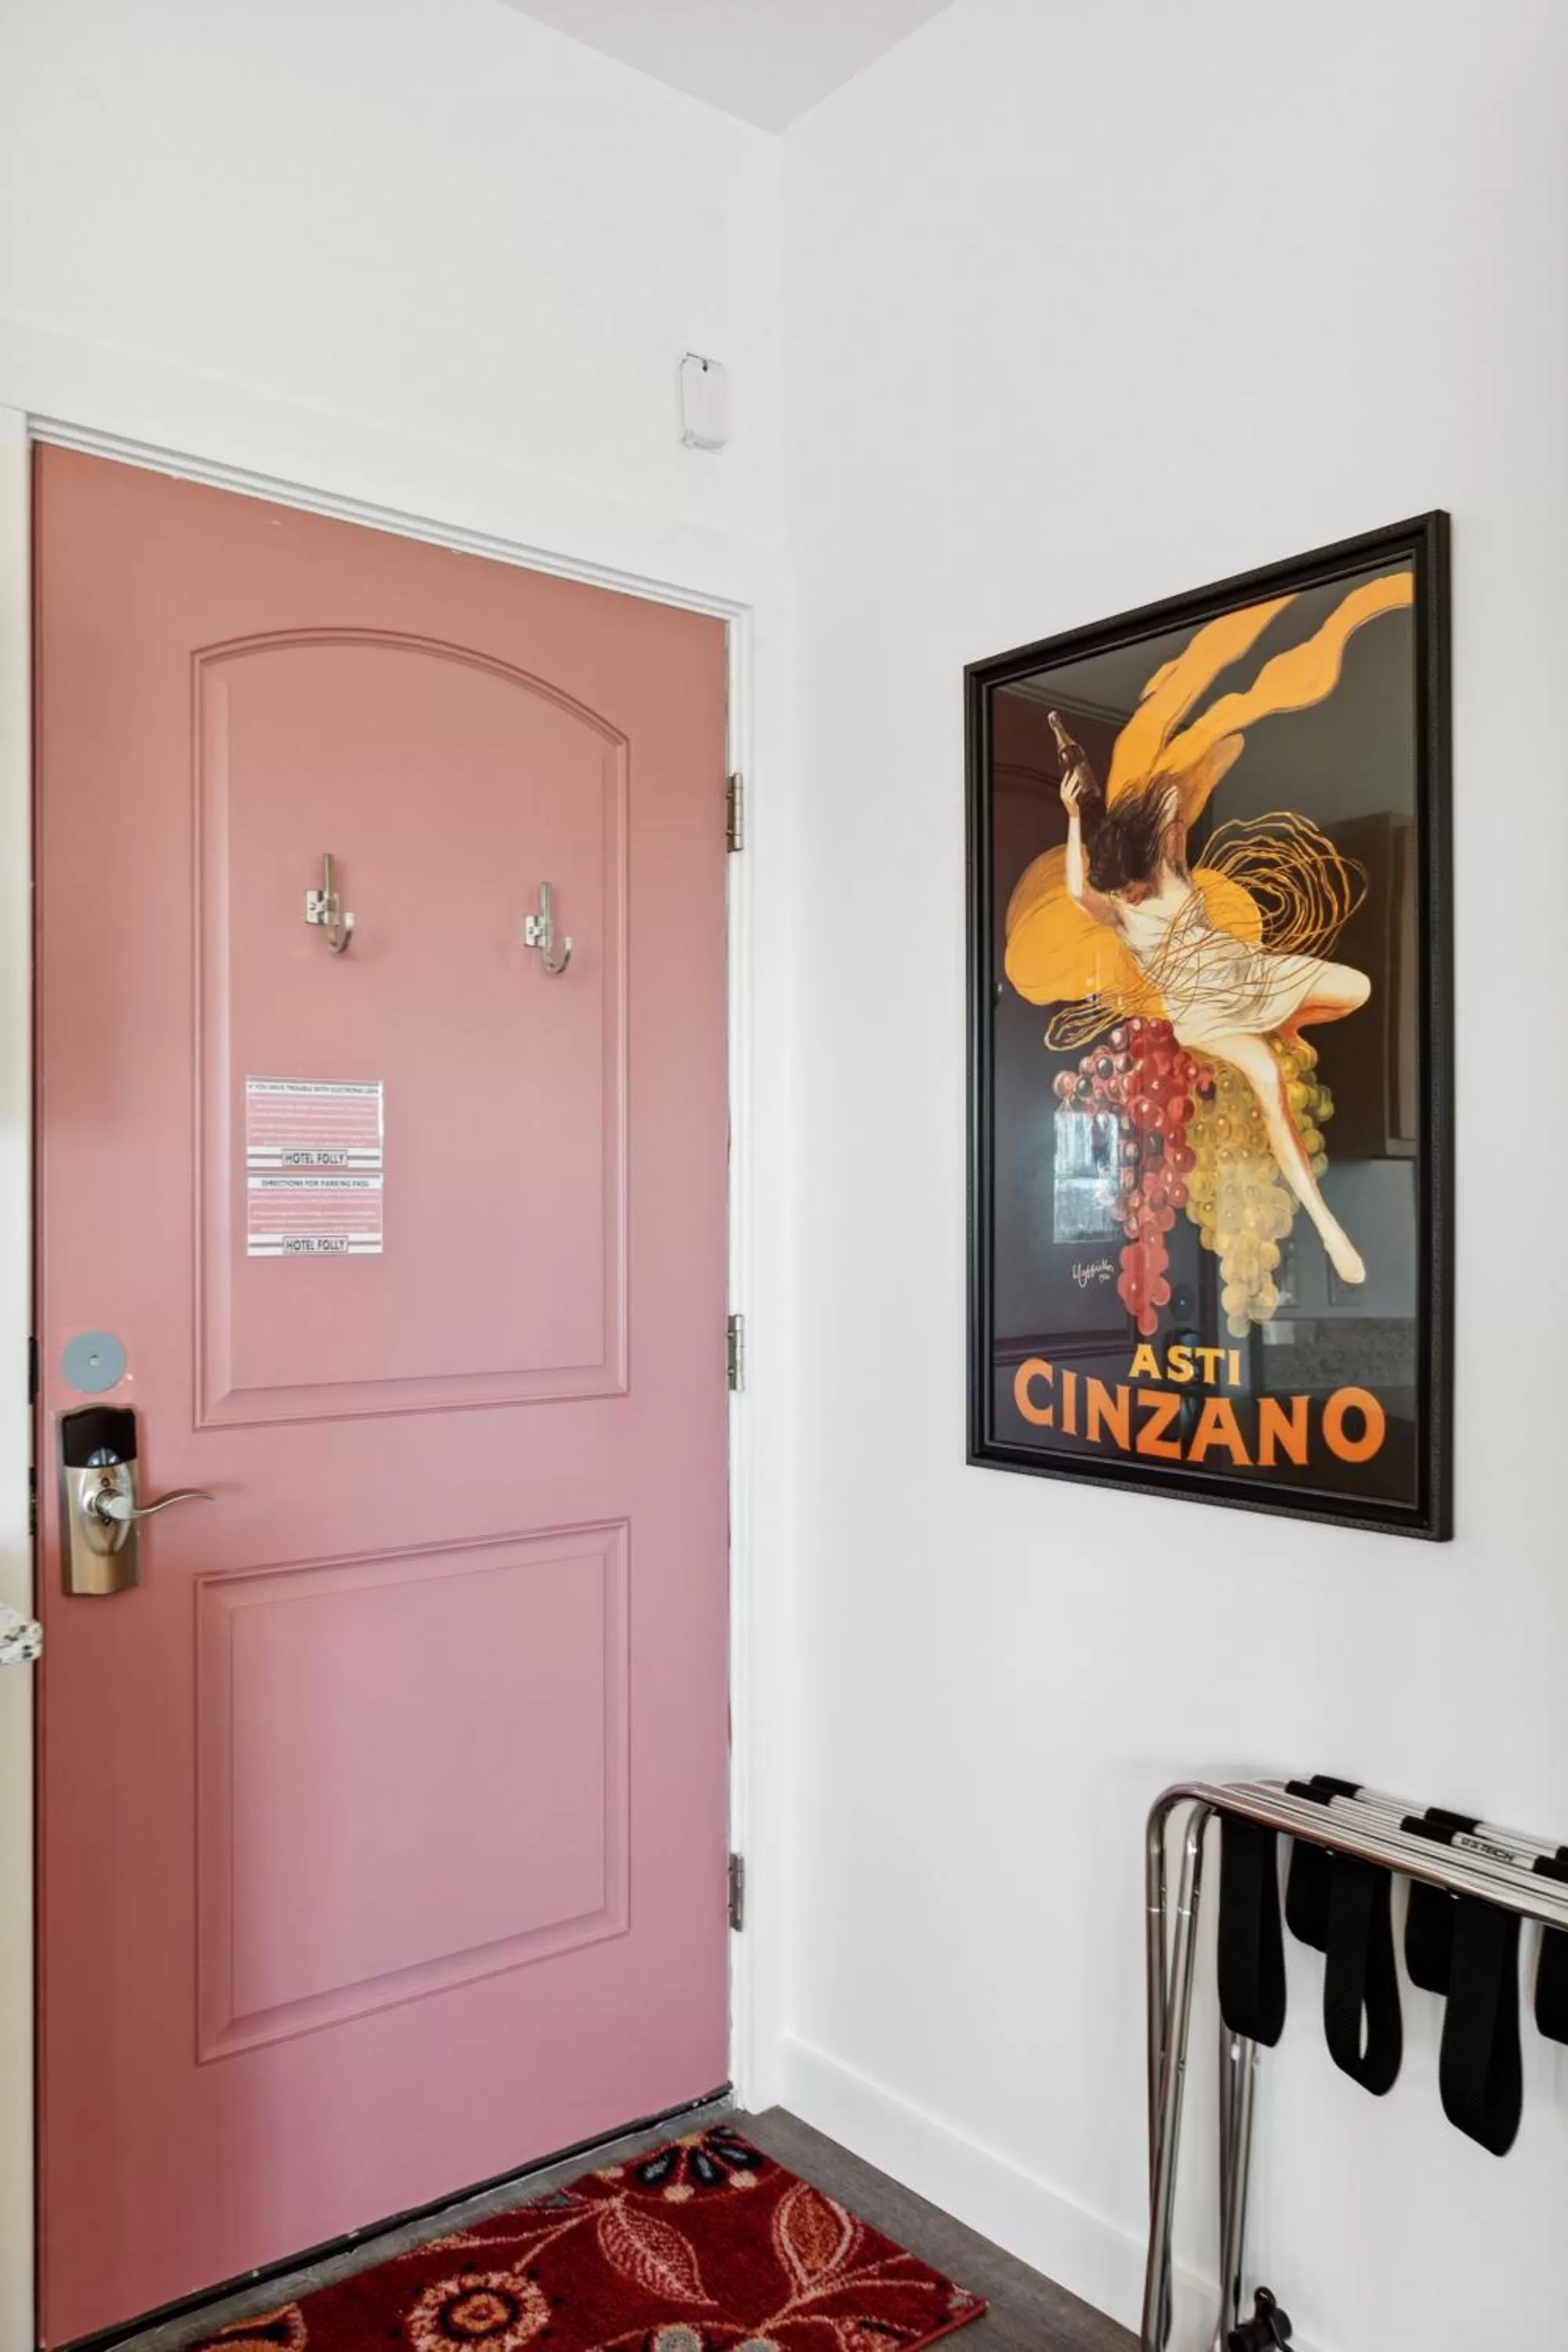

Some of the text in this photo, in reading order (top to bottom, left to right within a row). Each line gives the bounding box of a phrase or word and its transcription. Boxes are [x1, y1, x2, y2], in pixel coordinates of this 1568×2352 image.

[285, 1153, 344, 1164] HOTEL FOLLY
[286, 1240, 344, 1250] HOTEL FOLLY
[1128, 1343, 1242, 1386] ASTI
[1013, 1357, 1387, 1467] CINZANO
